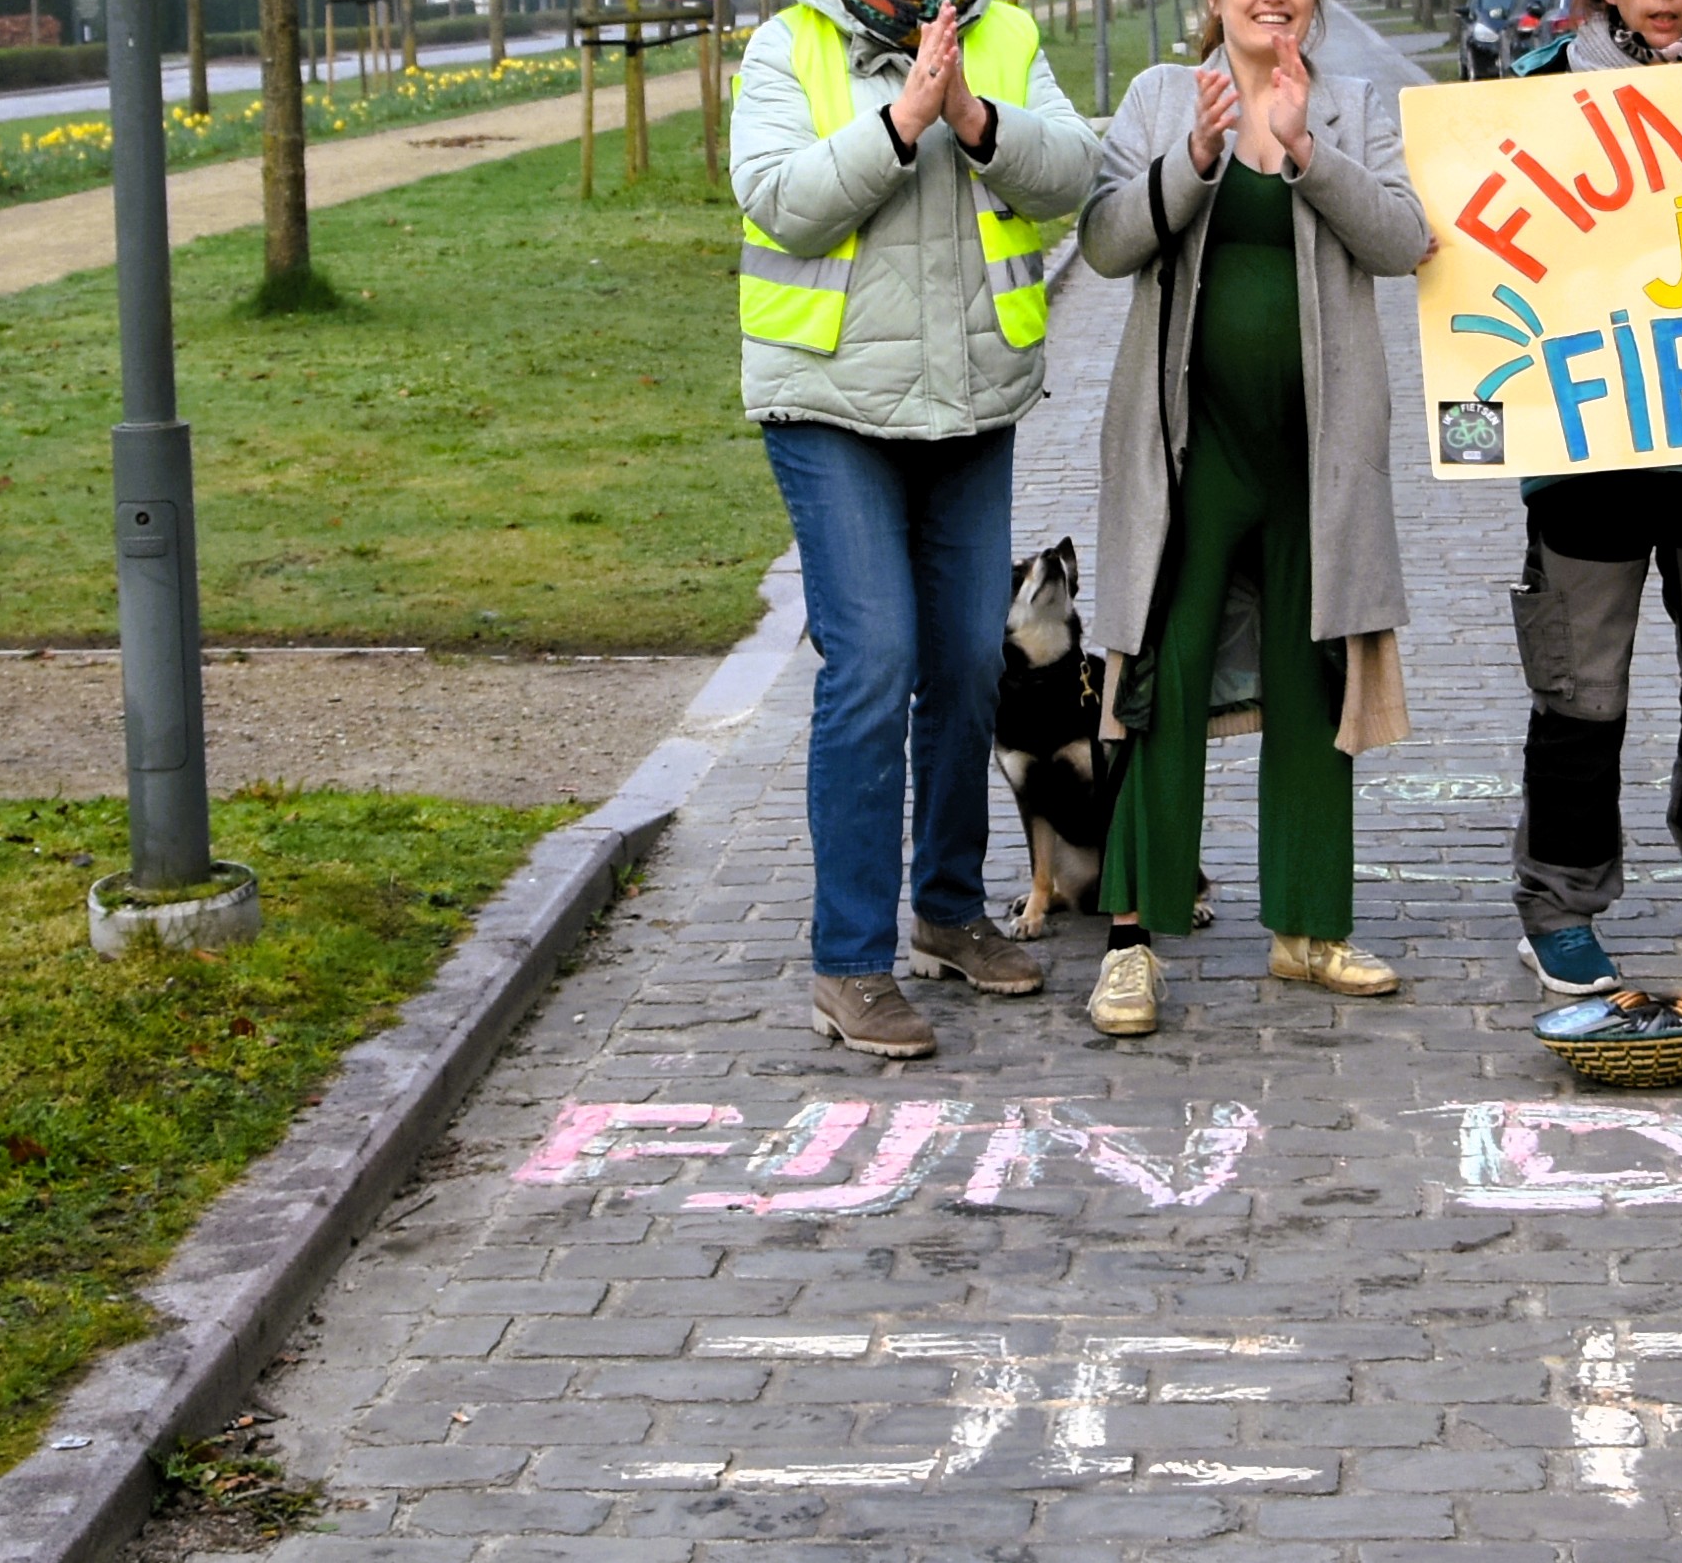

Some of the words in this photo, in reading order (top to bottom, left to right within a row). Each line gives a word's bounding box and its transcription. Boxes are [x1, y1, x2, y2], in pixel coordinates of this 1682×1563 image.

[1442, 414, 1454, 426] IK
[1460, 403, 1500, 426] FIETSEN
[602, 1331, 1326, 1488] JE
